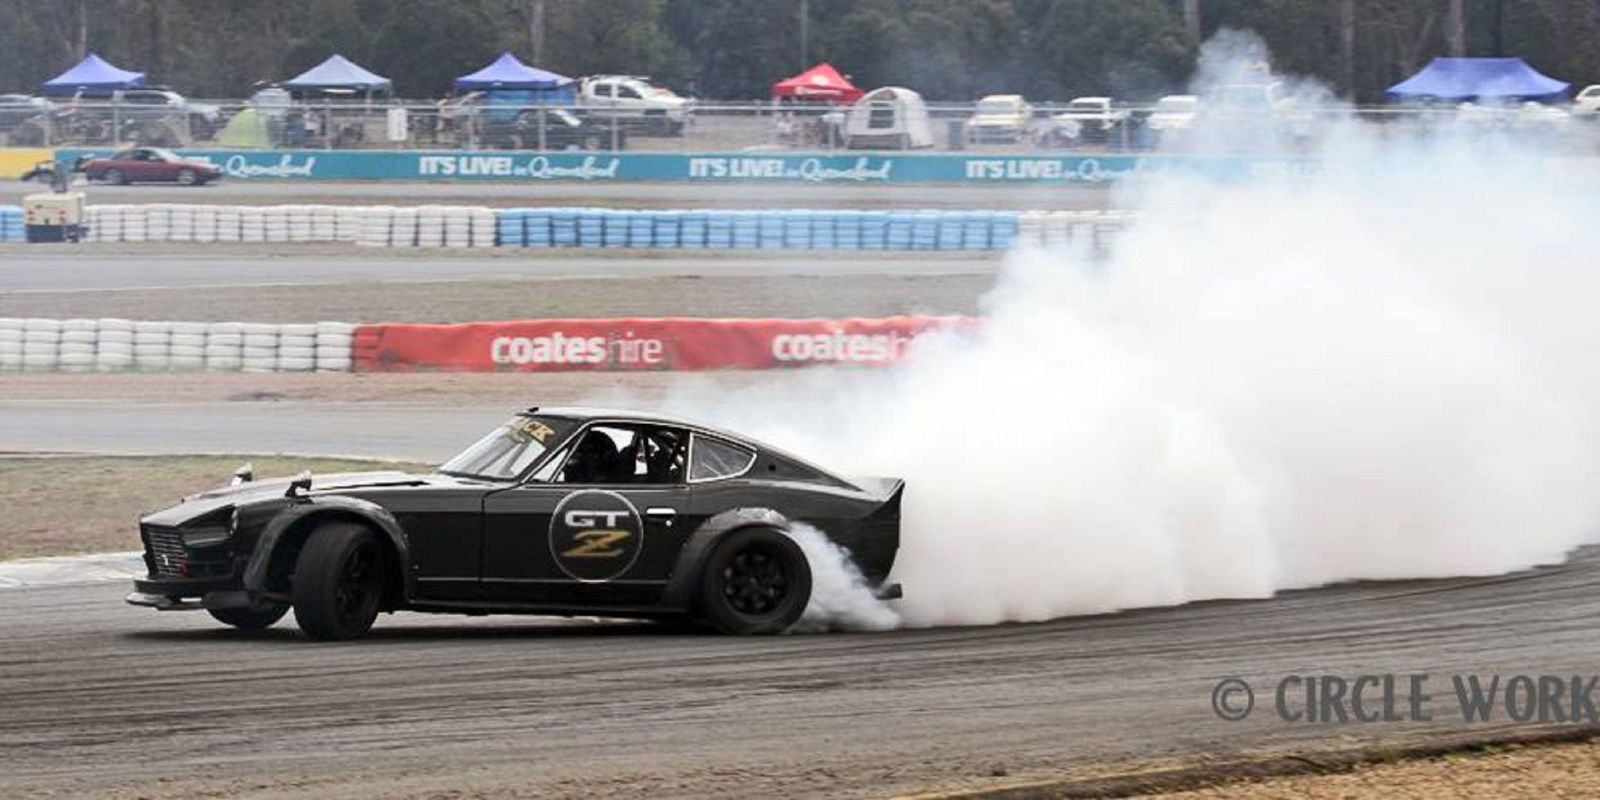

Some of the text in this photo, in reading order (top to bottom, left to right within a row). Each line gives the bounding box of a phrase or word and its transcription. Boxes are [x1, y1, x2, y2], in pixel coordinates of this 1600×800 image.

[419, 156, 456, 175] IT'S
[458, 156, 512, 175] LIVE!
[689, 158, 727, 177] IT'S
[729, 158, 785, 177] LIVE!
[965, 160, 1004, 179] IT'S
[1007, 160, 1062, 179] LIVE!
[565, 510, 629, 527] GT
[561, 530, 631, 557] Z
